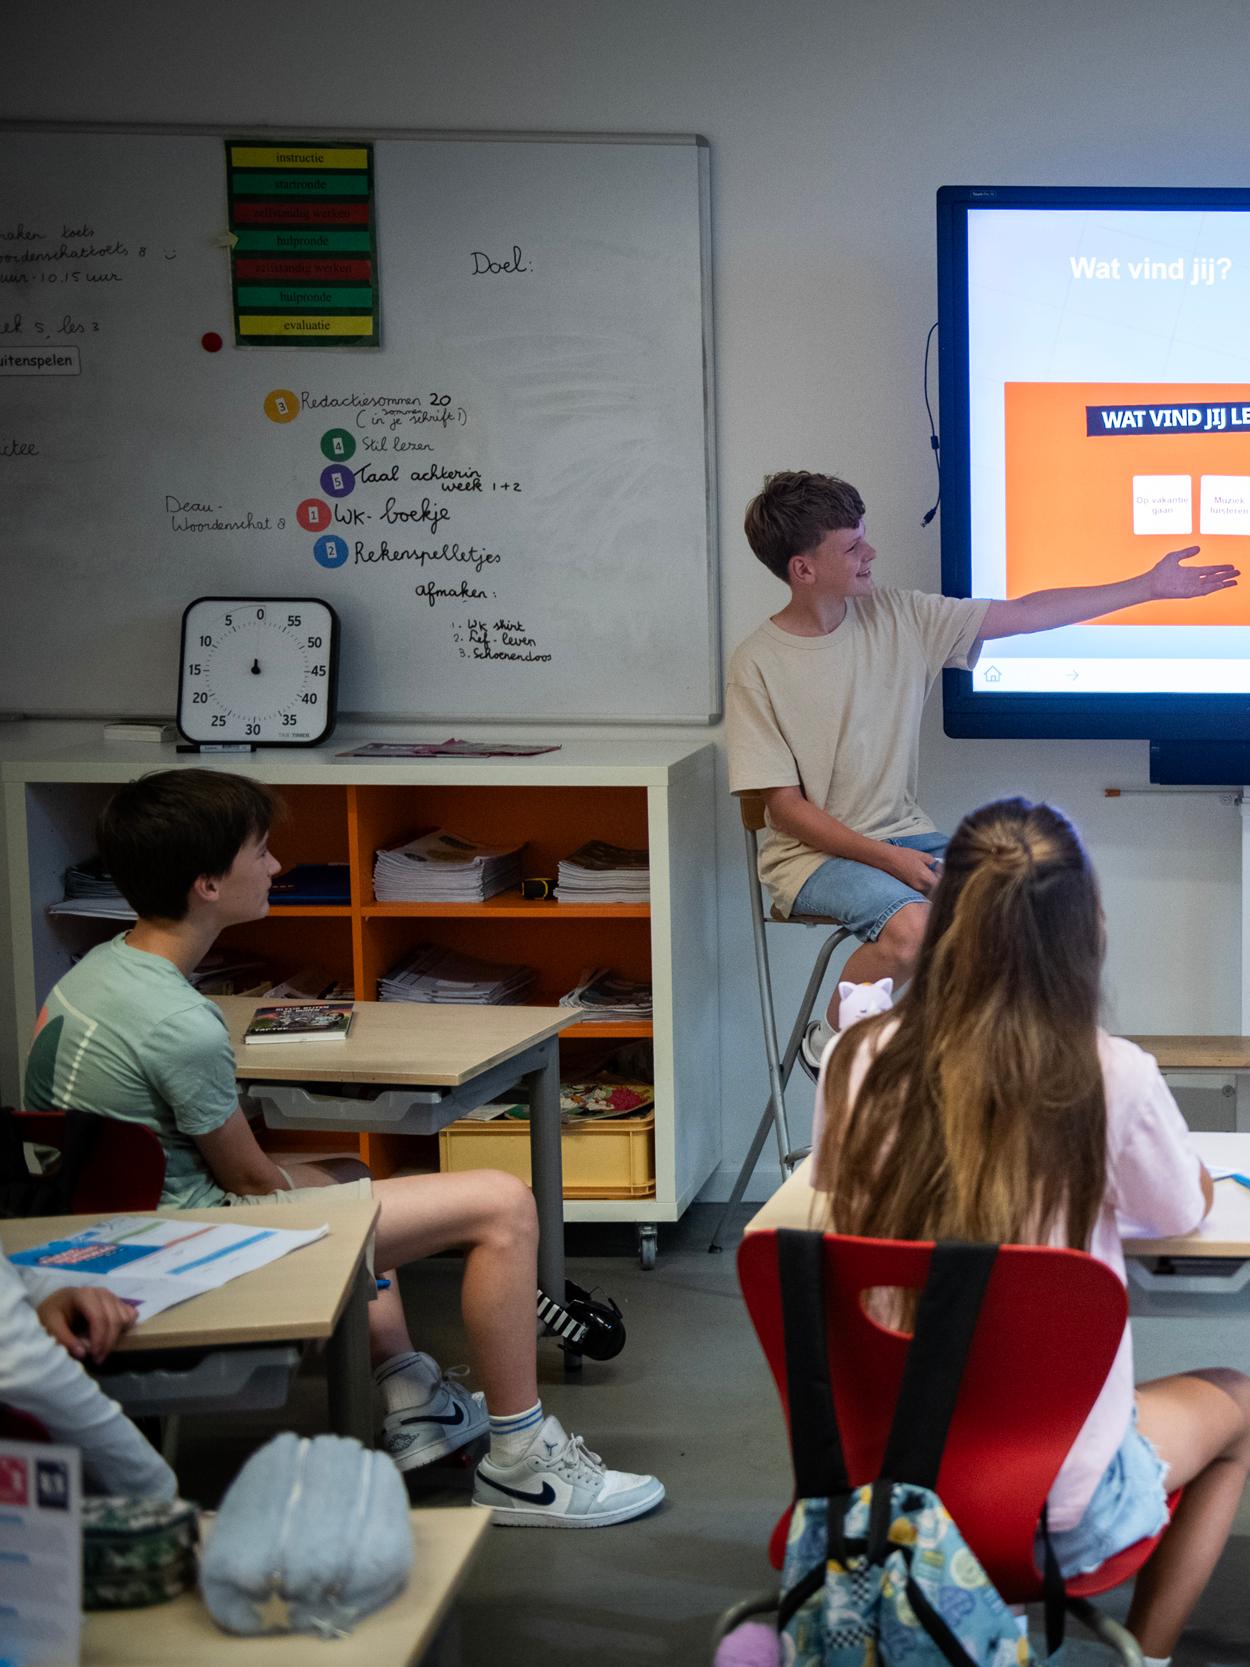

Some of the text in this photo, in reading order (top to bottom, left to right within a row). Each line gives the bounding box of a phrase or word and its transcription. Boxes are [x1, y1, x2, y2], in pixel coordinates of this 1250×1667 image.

[276, 152, 324, 163] instructie
[275, 179, 327, 189] startronde
[277, 235, 328, 248] hulpronde
[470, 245, 534, 275] Doel:
[1069, 257, 1232, 285] Wat vind jij?
[280, 291, 332, 304] hulpronde
[284, 320, 330, 331] evaluatie
[278, 401, 287, 412] 3
[301, 391, 452, 410] Redactiesommen 20
[1102, 411, 1146, 429] WAT
[1149, 409, 1202, 427] VIND
[1204, 408, 1227, 430] JIJ
[335, 442, 342, 451] 4
[362, 436, 387, 451] Stil
[334, 476, 342, 486] 5
[441, 478, 484, 492] week
[171, 511, 273, 532] Woordenschat
[311, 511, 317, 521] 1
[328, 546, 335, 556] 2
[354, 541, 501, 573] Rekenspelletjes
[225, 614, 233, 627] 5
[256, 608, 265, 621] 0
[287, 615, 302, 628] 55
[200, 635, 212, 647] 10
[307, 636, 322, 649] 50
[189, 664, 201, 675] 15
[311, 664, 326, 677] 45
[192, 692, 208, 704] 20
[301, 692, 317, 704] 40
[211, 715, 227, 727] 25
[281, 714, 297, 726] 35
[244, 723, 261, 736] 30
